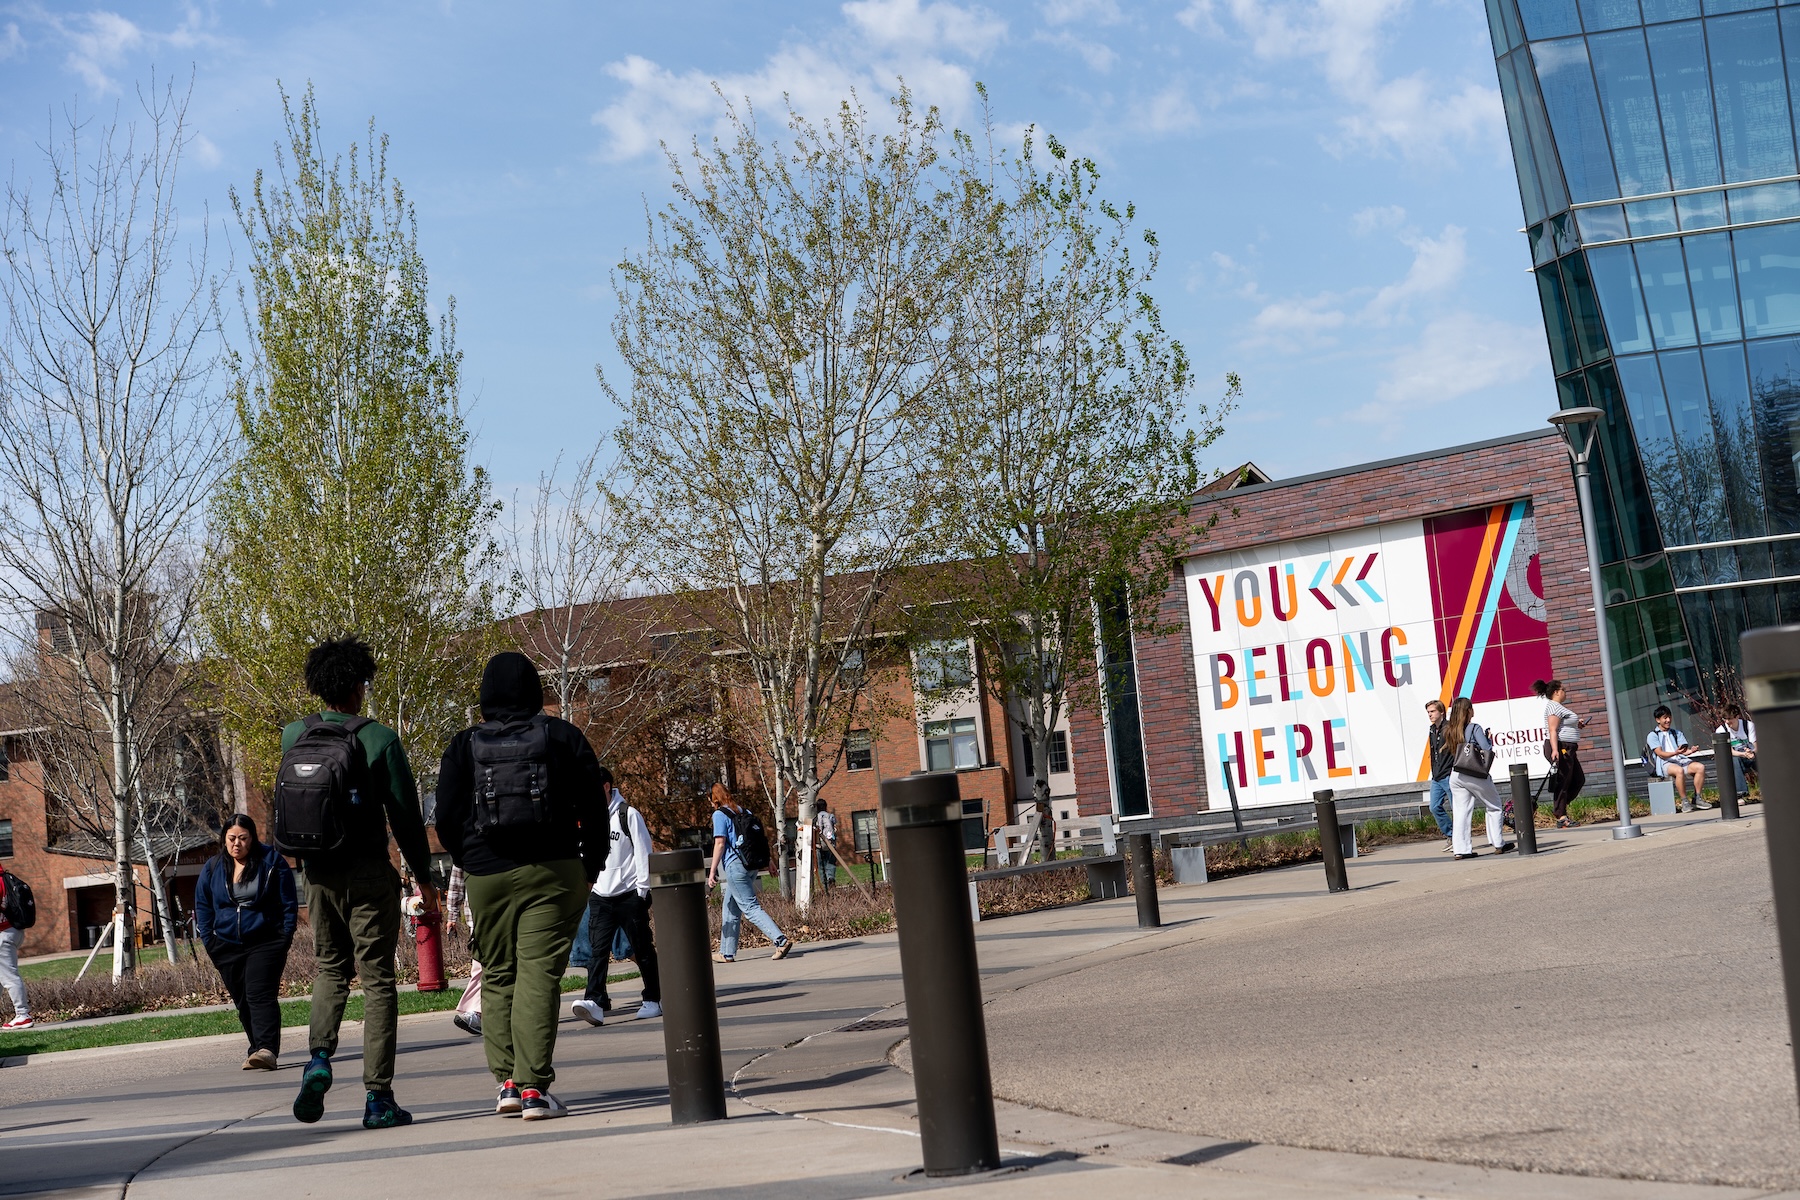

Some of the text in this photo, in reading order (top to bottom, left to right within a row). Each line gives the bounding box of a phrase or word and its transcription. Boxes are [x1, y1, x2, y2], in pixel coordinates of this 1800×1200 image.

[1198, 562, 1298, 632] YOU
[1209, 626, 1413, 710] BELONG
[1217, 718, 1368, 790] HERE.
